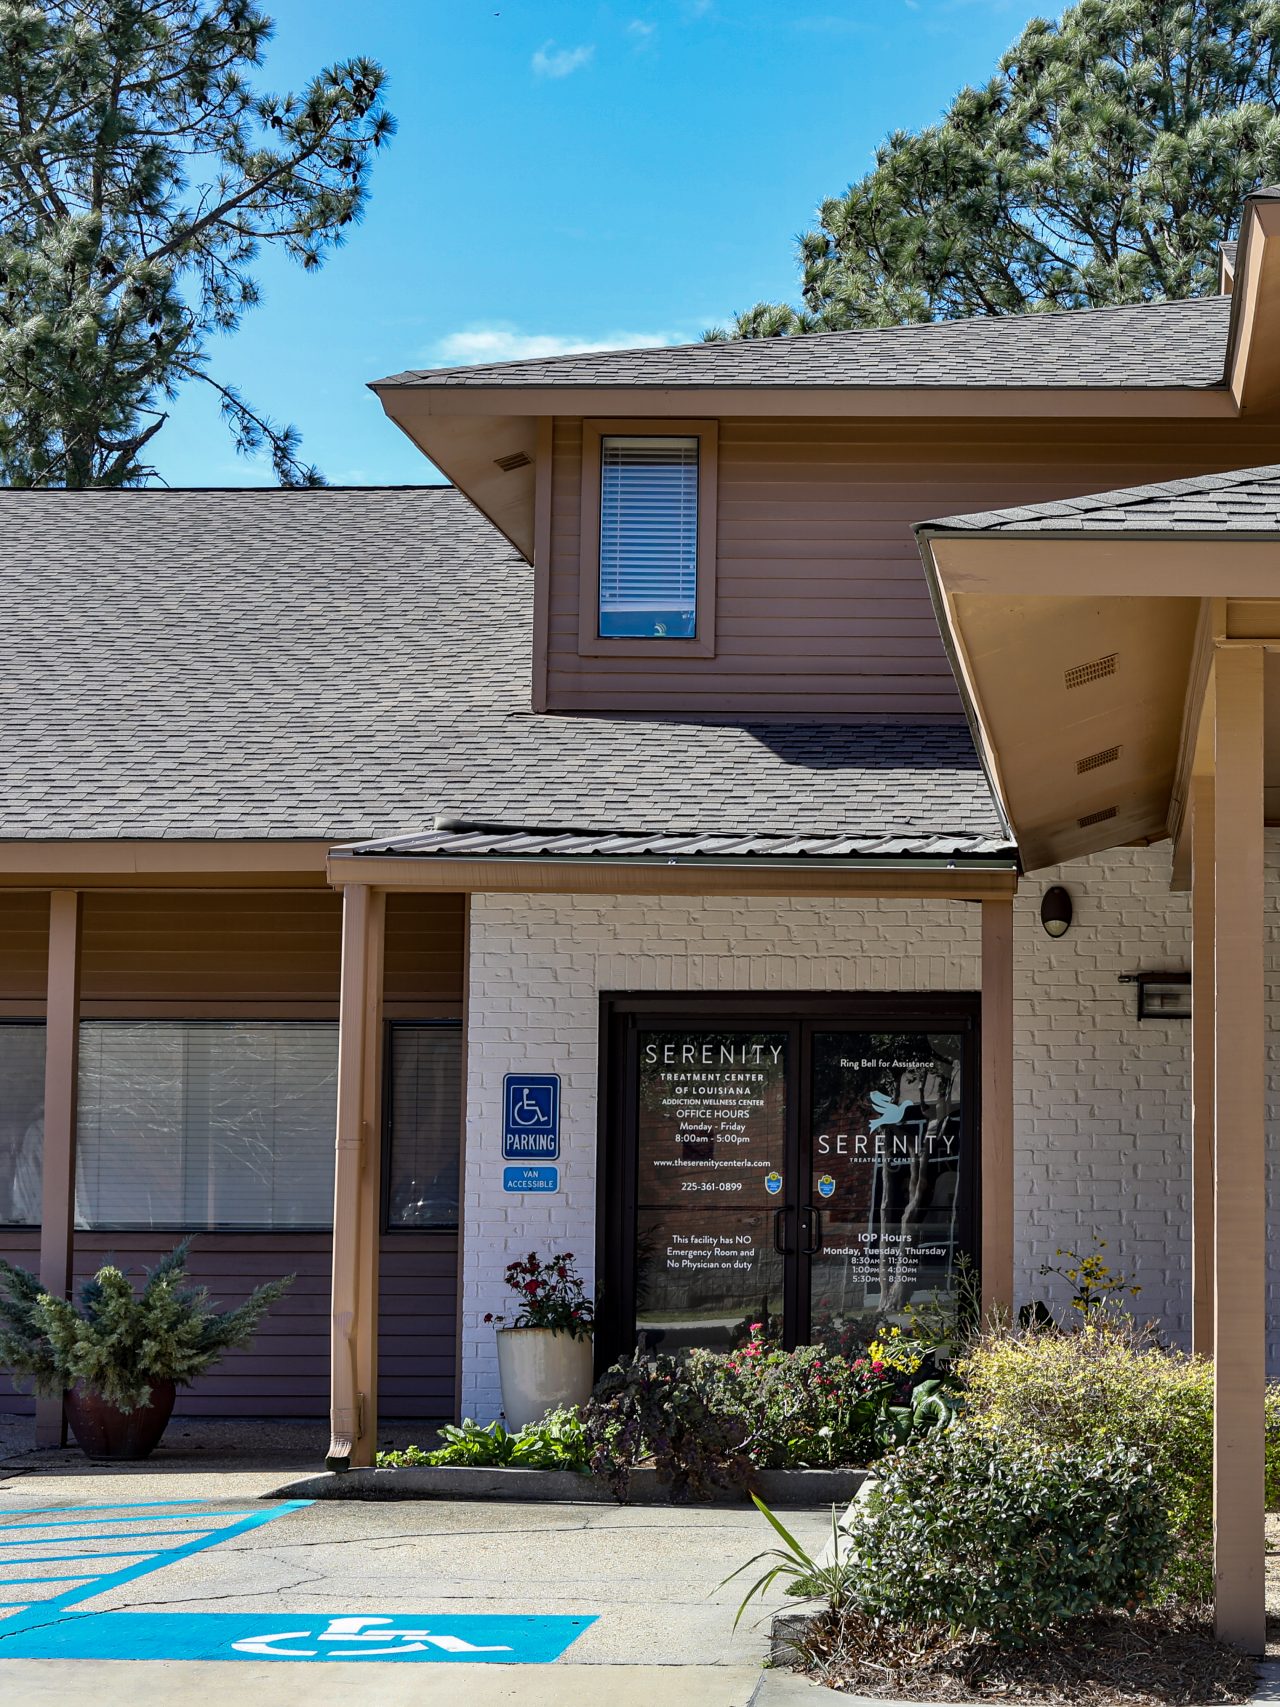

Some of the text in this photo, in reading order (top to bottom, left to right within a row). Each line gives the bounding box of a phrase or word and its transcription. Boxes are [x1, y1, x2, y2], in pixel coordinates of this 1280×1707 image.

[645, 1044, 782, 1064] SERENITY
[840, 1059, 934, 1070] Ring Bell for Assistance
[676, 1110, 750, 1118] OFFICE HOURS
[680, 1122, 712, 1133] Monday
[721, 1123, 746, 1133] Friday
[507, 1134, 555, 1150] PARKING
[675, 1134, 708, 1142] 8:00am
[716, 1135, 750, 1145] 5:00pm
[818, 1135, 955, 1154] SERENITY
[654, 1158, 770, 1169] www.theserenitycenterla.com
[681, 1182, 742, 1191] 225-361-0899
[672, 1235, 751, 1246] This facility has NO
[858, 1234, 912, 1242] IOP Hours
[667, 1248, 754, 1258] Emergency Room and
[823, 1247, 946, 1256] Monday, Tuesday, Thursday
[667, 1260, 679, 1268] No
[681, 1260, 720, 1270] Physician
[734, 1260, 752, 1270] duty
